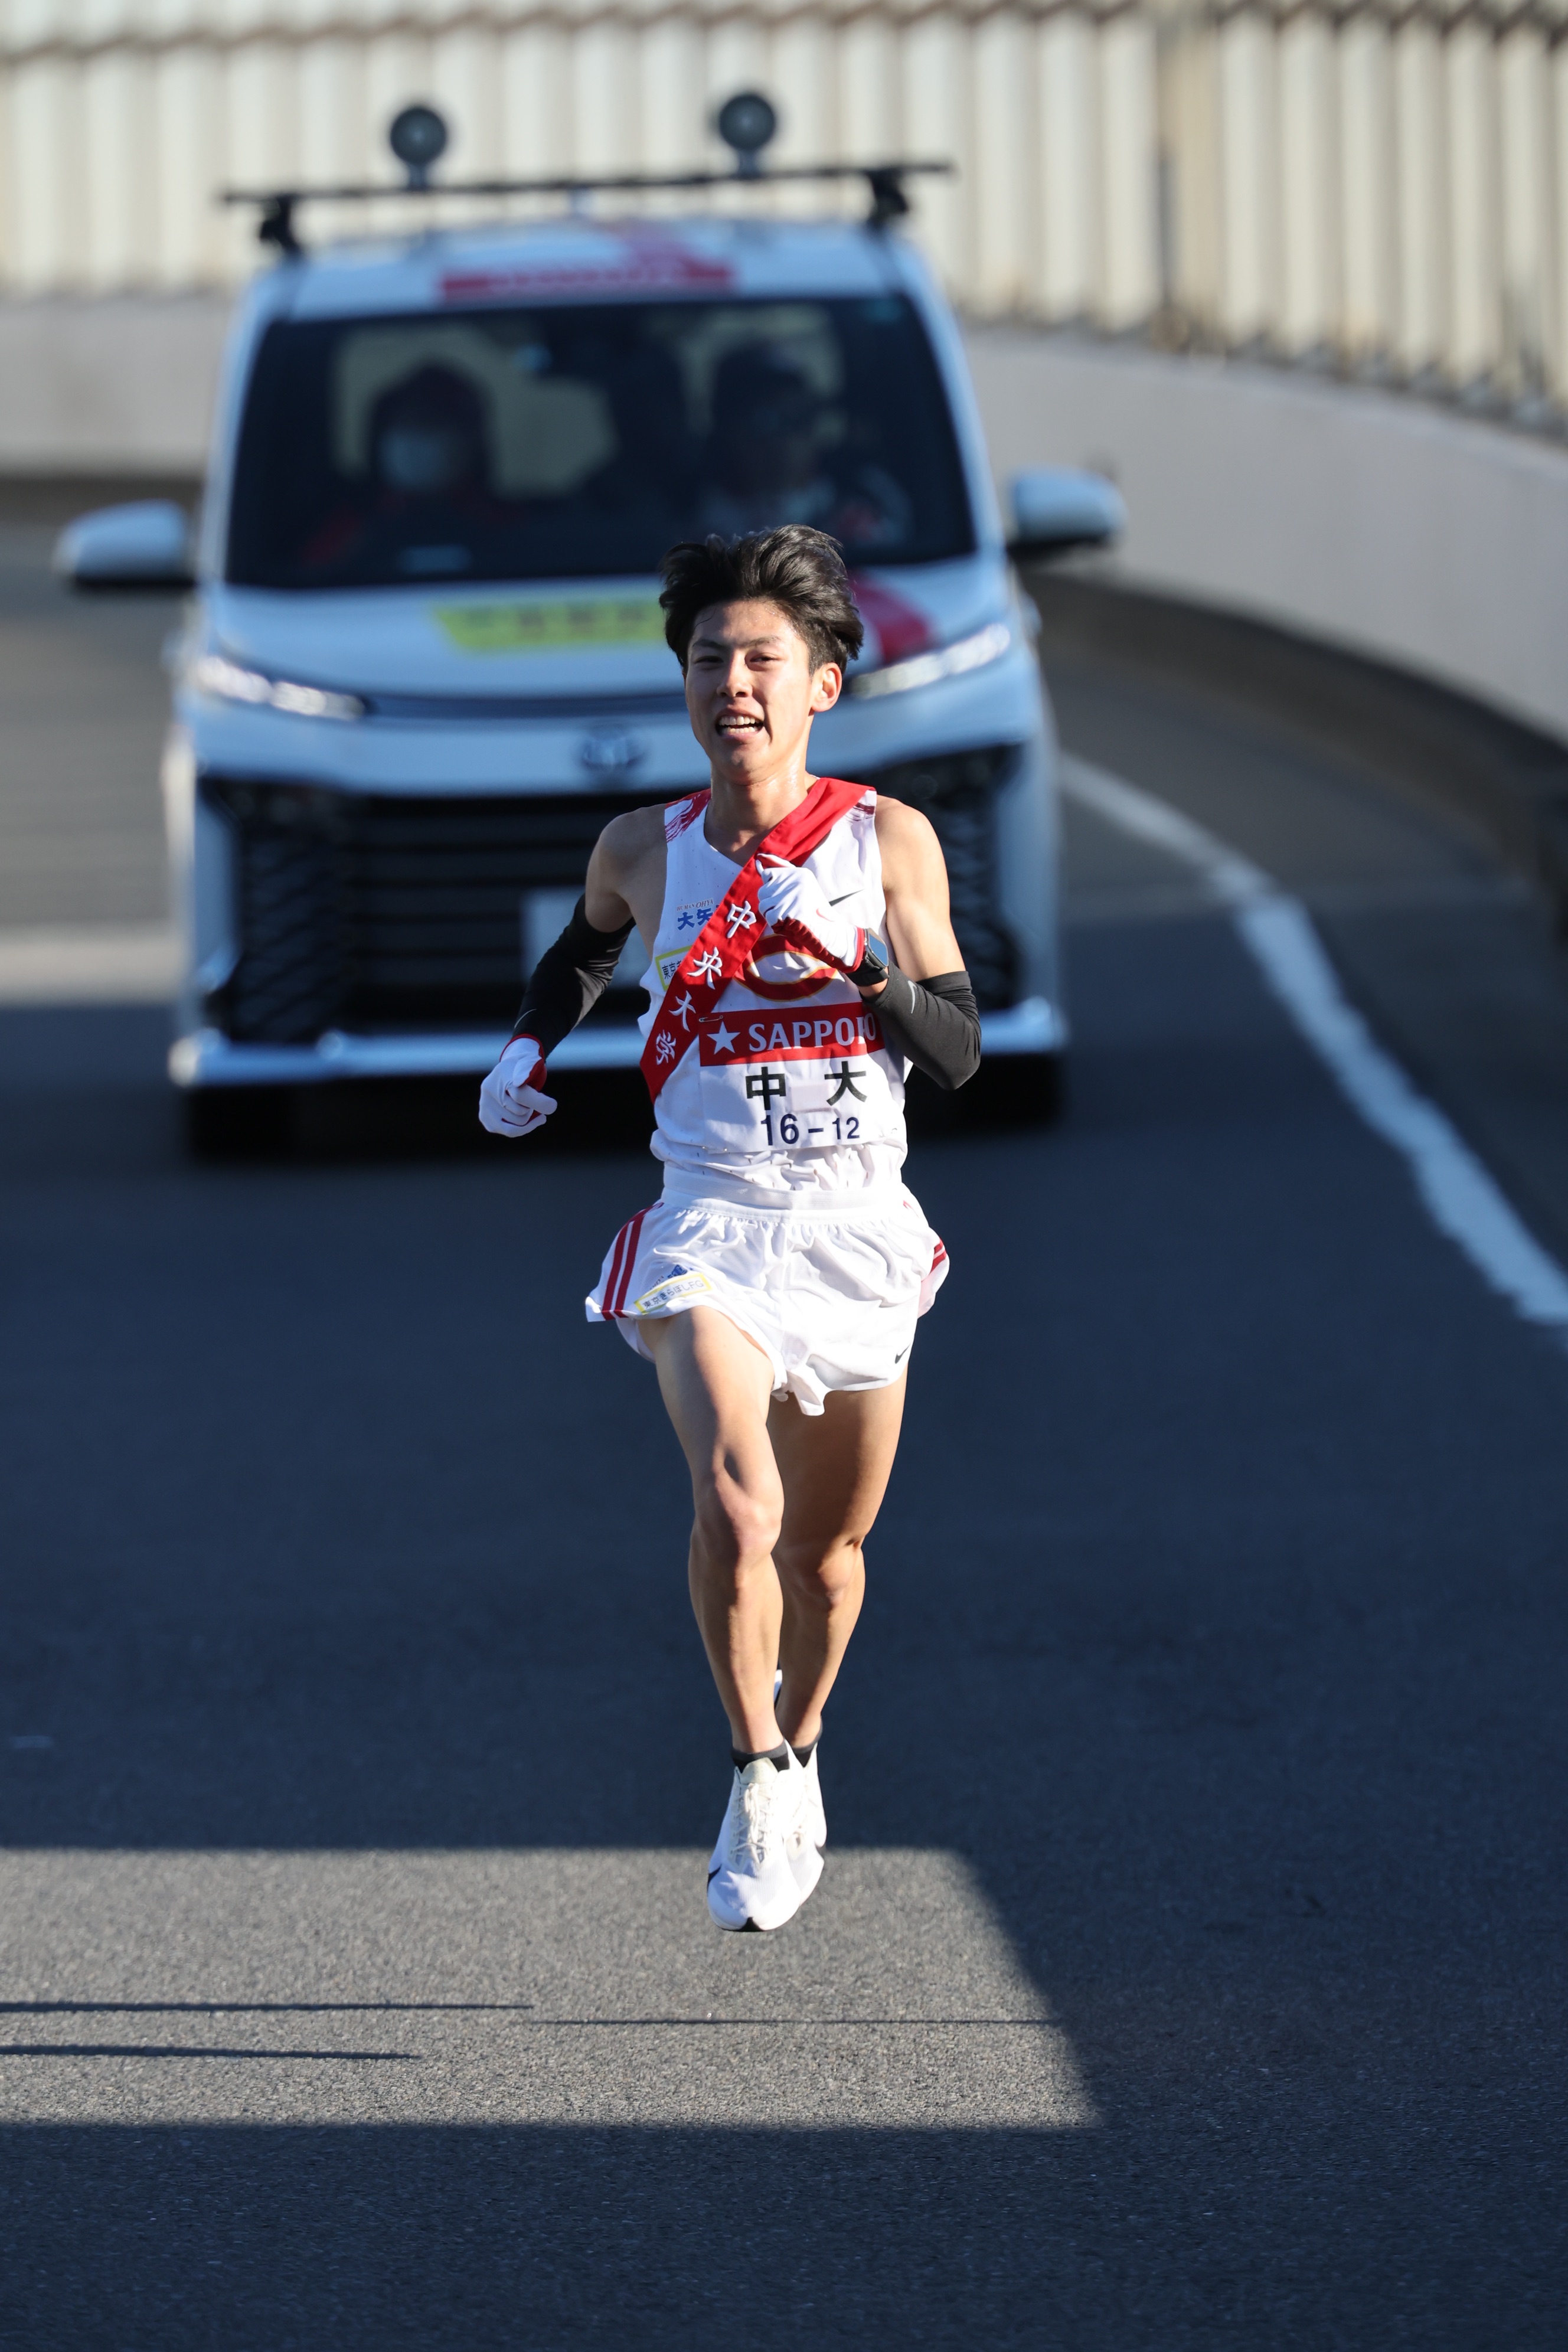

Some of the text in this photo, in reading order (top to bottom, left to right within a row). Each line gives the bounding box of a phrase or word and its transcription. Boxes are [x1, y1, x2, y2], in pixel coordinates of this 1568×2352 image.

[677, 904, 718, 930] 大矢
[696, 899, 714, 909] OHYA
[760, 1113, 860, 1146] 16-12
